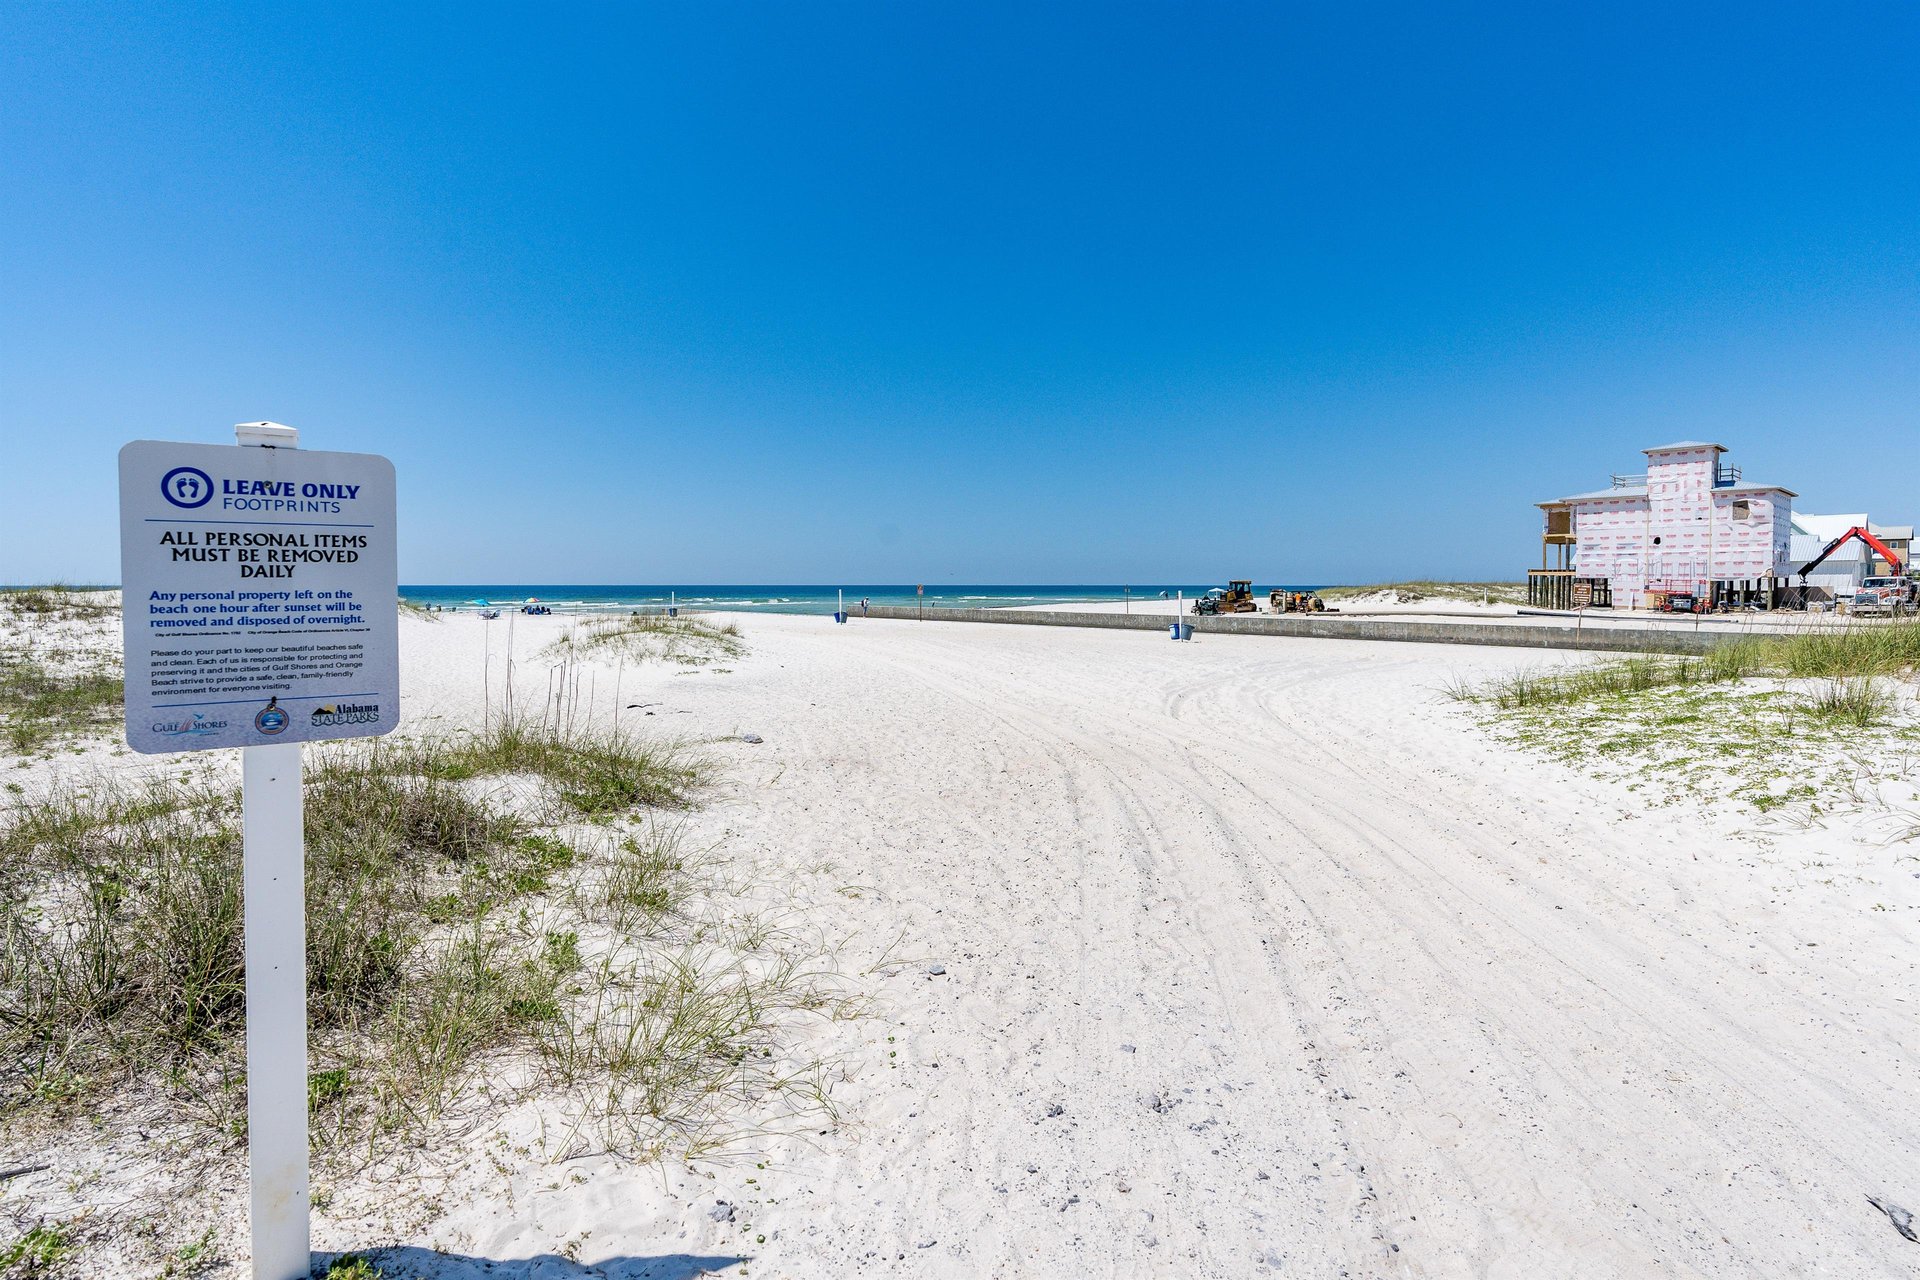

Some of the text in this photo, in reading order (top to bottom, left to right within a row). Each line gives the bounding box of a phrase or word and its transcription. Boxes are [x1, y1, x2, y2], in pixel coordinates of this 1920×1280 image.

[223, 480, 360, 499] LEAVE ONLY
[223, 498, 341, 513] FOOTPRINTS
[160, 531, 367, 548] ALL PERSONAL ITEMS
[172, 548, 359, 563] MUST BE REMOVED
[241, 566, 295, 578] DAILY
[149, 591, 175, 603] Any
[180, 591, 234, 603] personal
[238, 591, 291, 602] property
[294, 590, 313, 600] left
[335, 590, 352, 598] the
[150, 602, 362, 613] beach one hour after sunset will be
[150, 614, 365, 627] removed and disposed of overnight.
[301, 671, 353, 679] family-friendly
[152, 688, 206, 696] environment
[222, 685, 260, 693] everyone
[336, 704, 378, 713] Alabama
[312, 712, 379, 723] STATE PARKS
